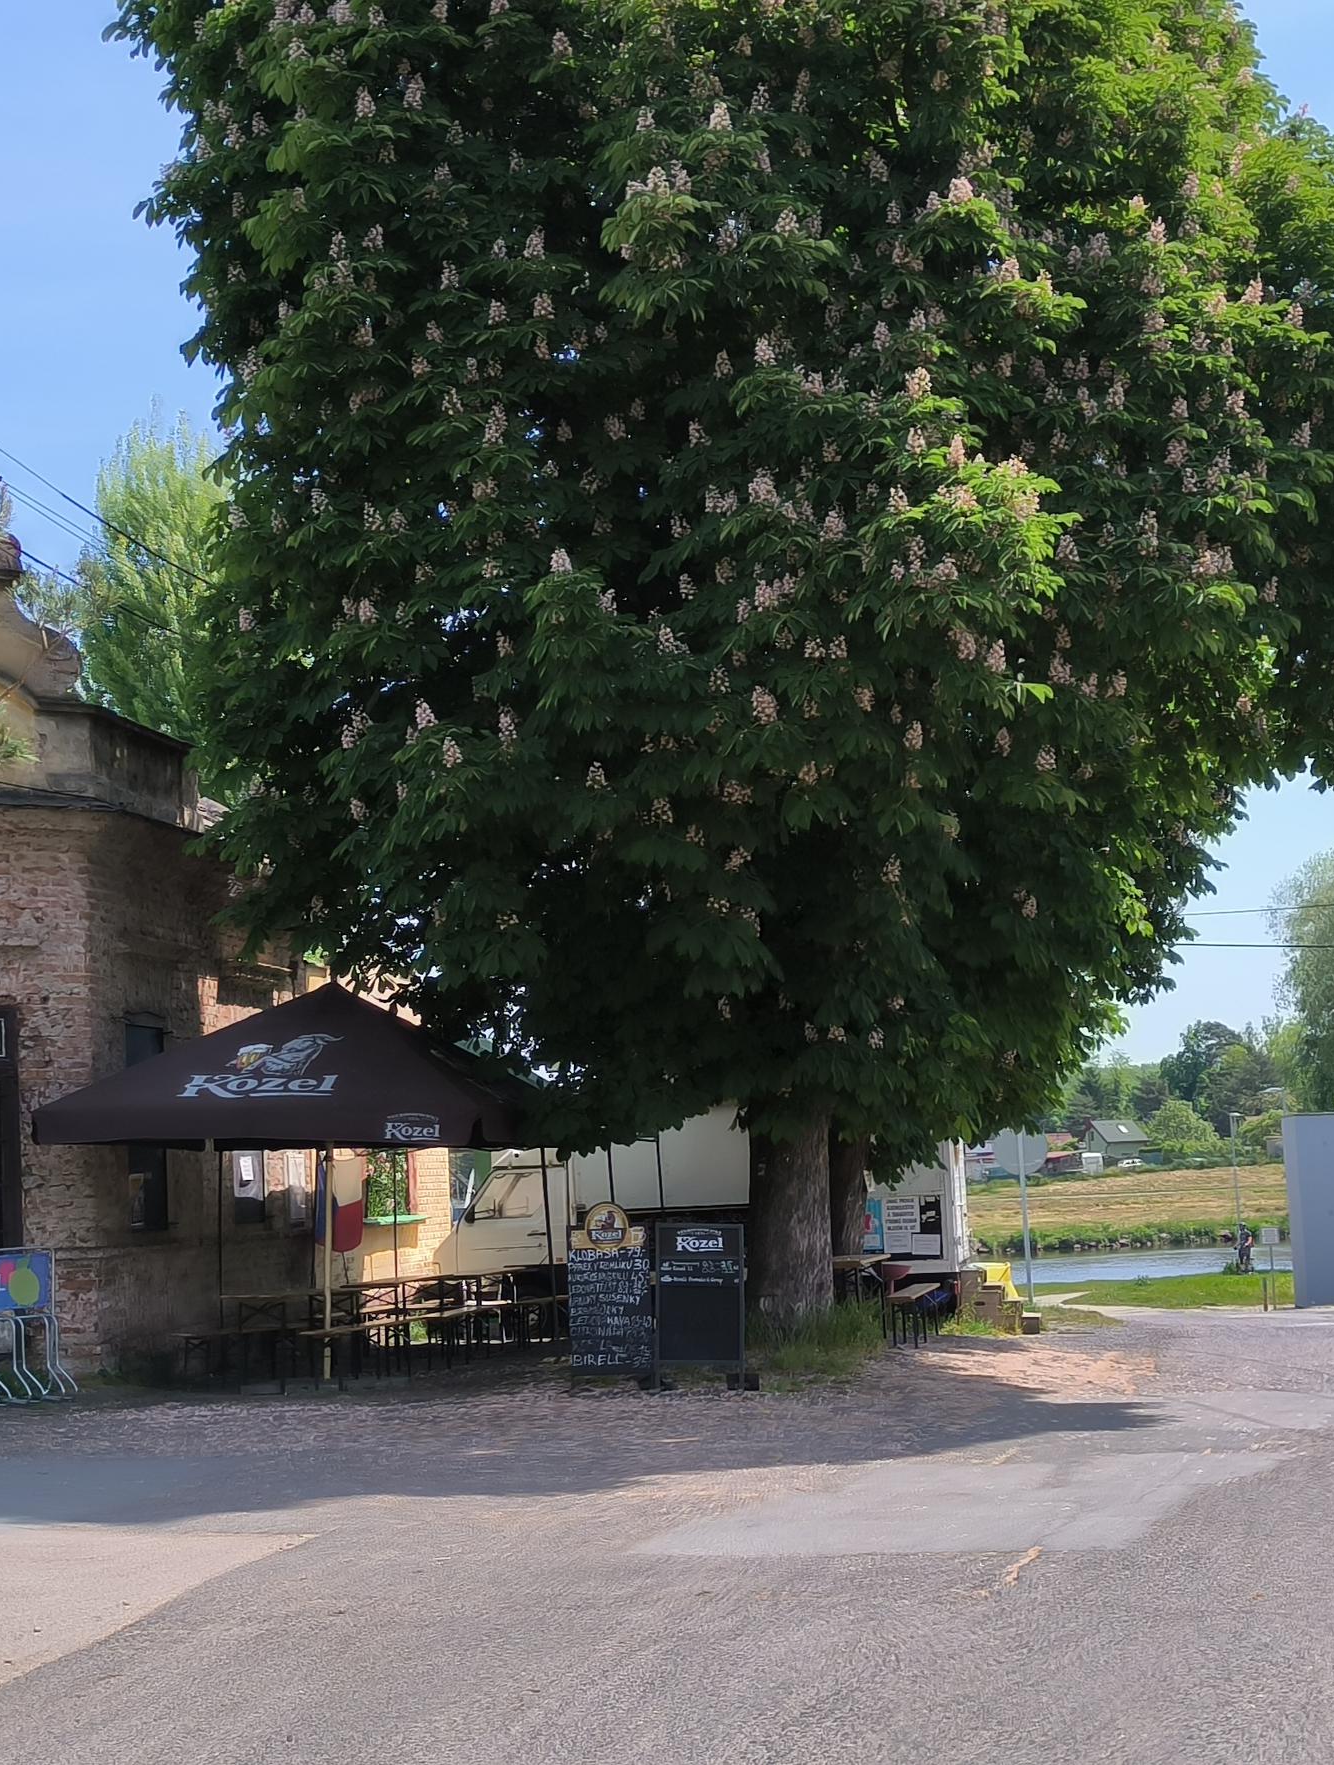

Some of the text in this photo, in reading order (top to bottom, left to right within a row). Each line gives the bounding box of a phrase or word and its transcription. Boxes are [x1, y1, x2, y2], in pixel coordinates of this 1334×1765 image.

[176, 1074, 339, 1098] Kozel
[384, 1122, 442, 1141] Kozel
[591, 1230, 623, 1241] Kozel
[675, 1236, 724, 1252] Kozel
